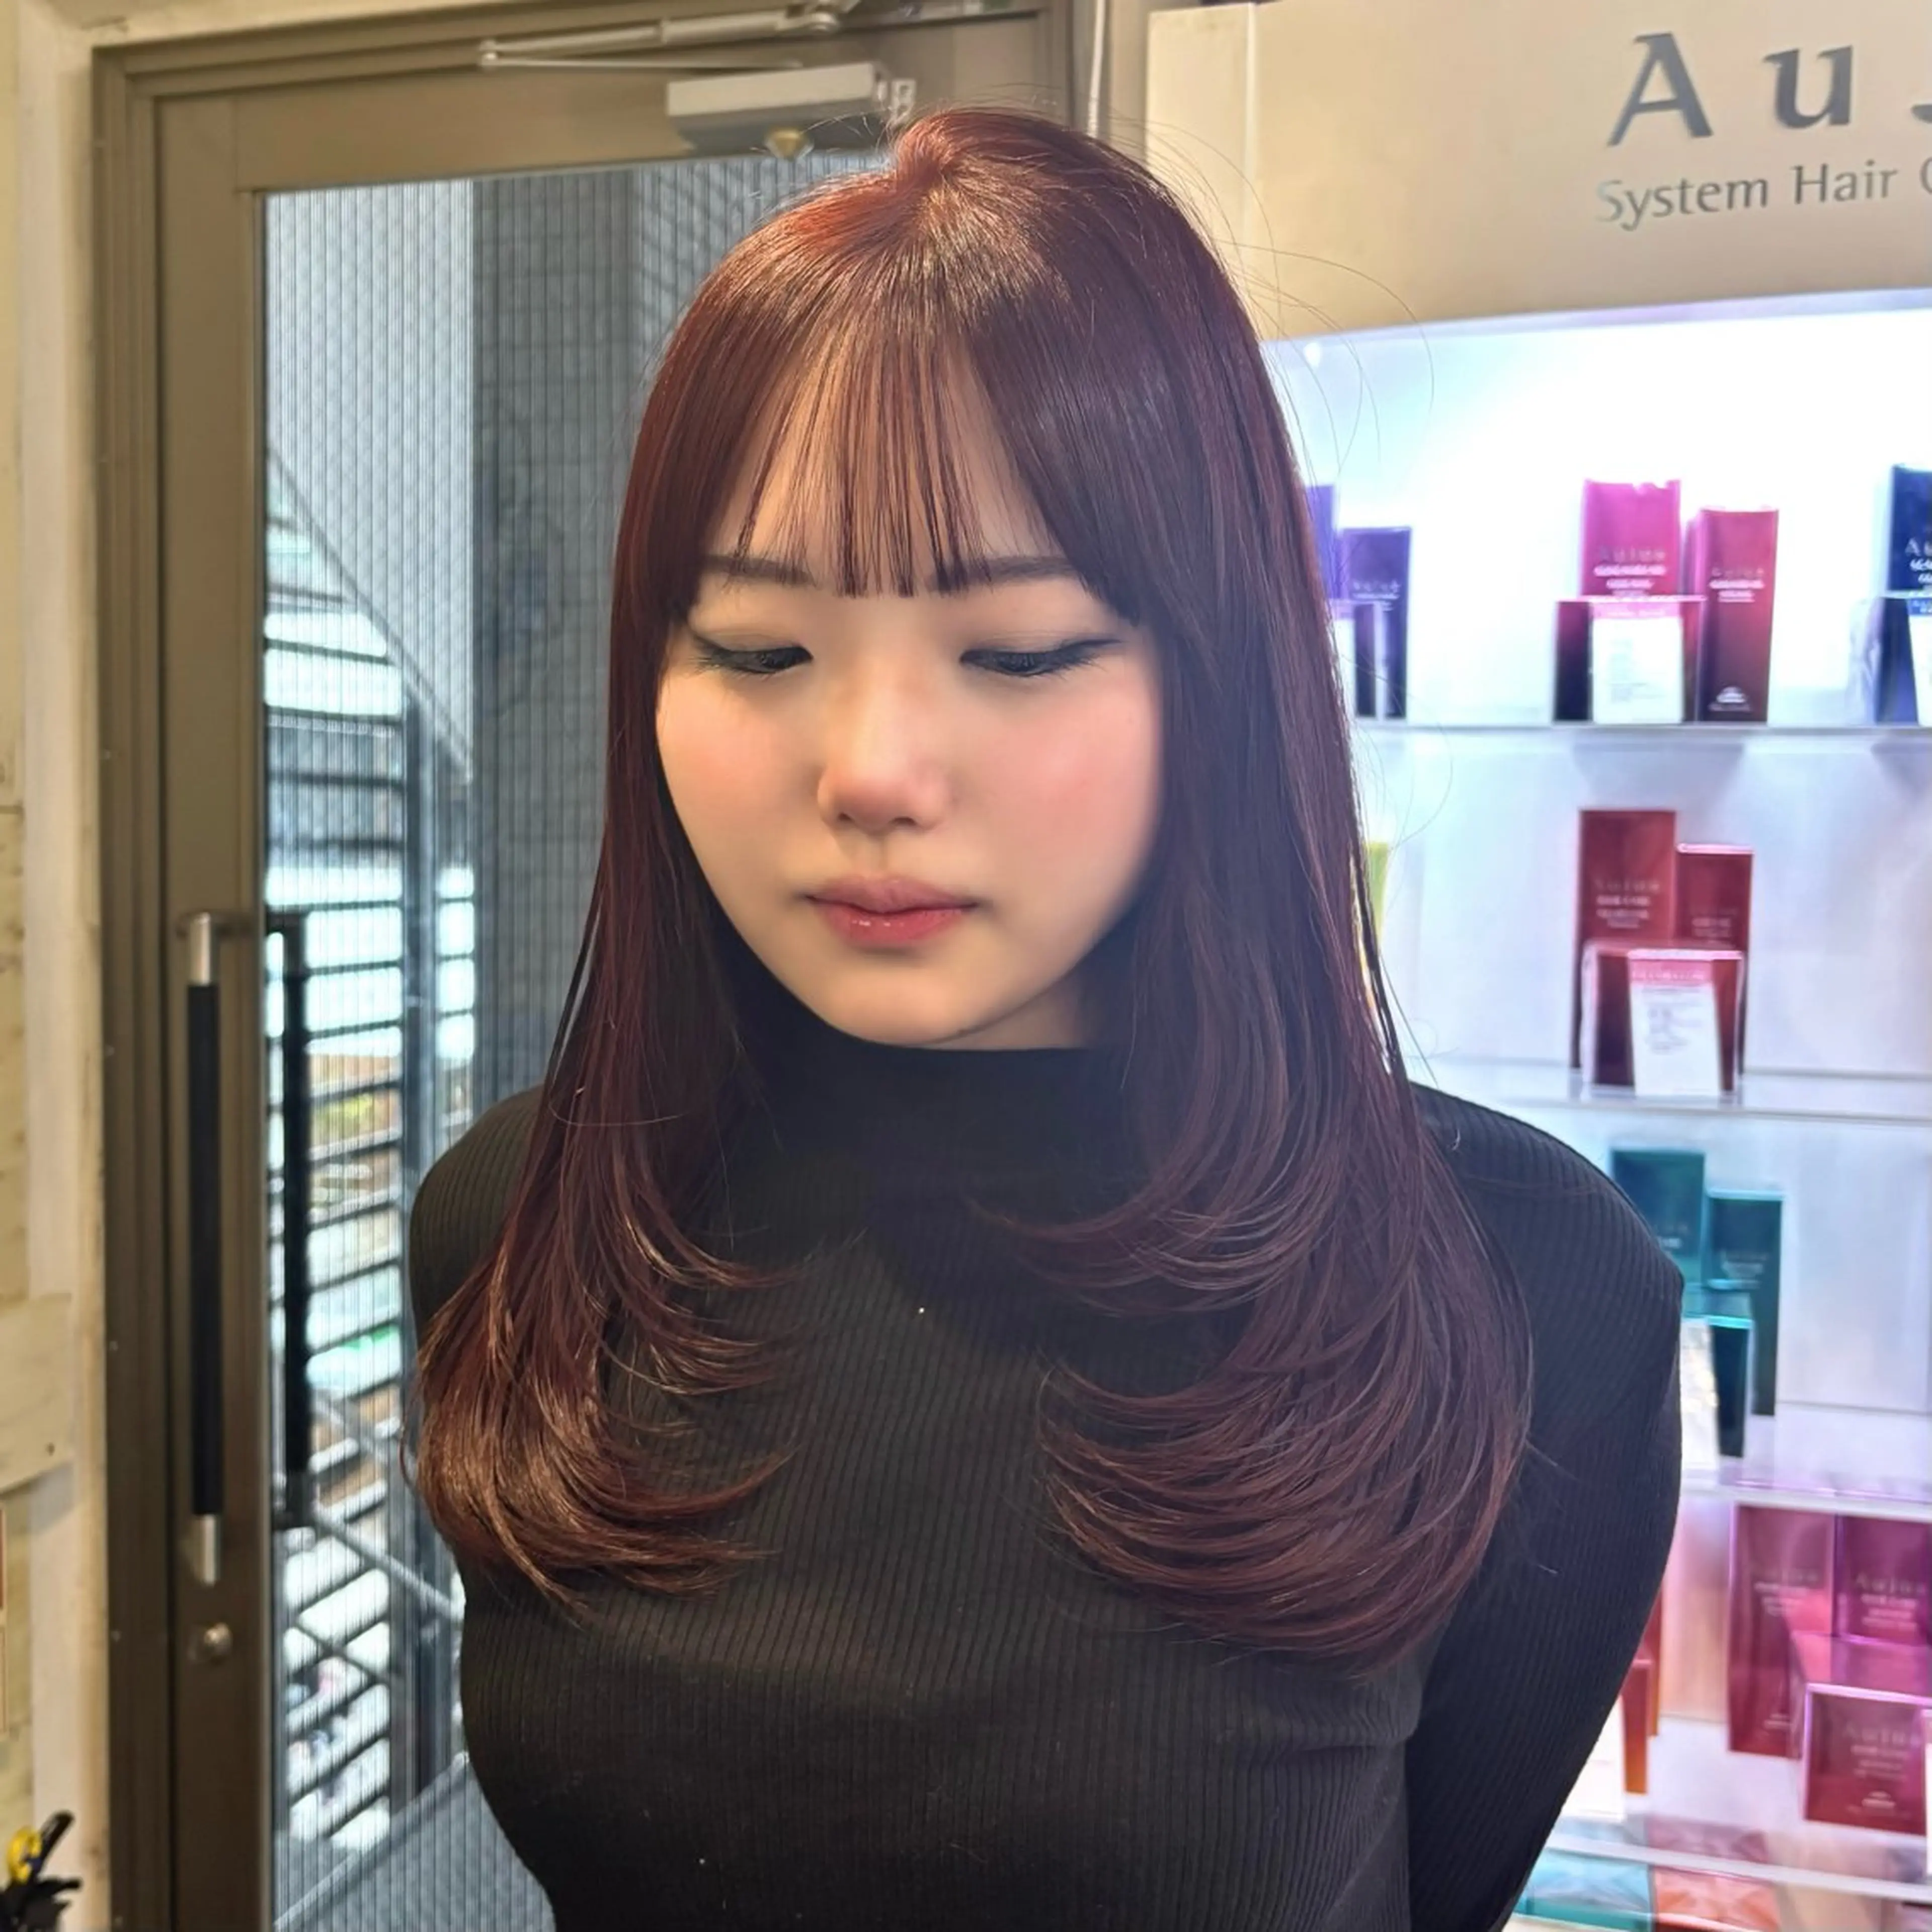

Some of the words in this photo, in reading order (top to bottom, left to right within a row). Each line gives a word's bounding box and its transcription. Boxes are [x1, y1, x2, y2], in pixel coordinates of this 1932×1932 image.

[1607, 32, 1932, 146] Au
[1596, 178, 1769, 231] System
[1791, 159, 1898, 205] Hair
